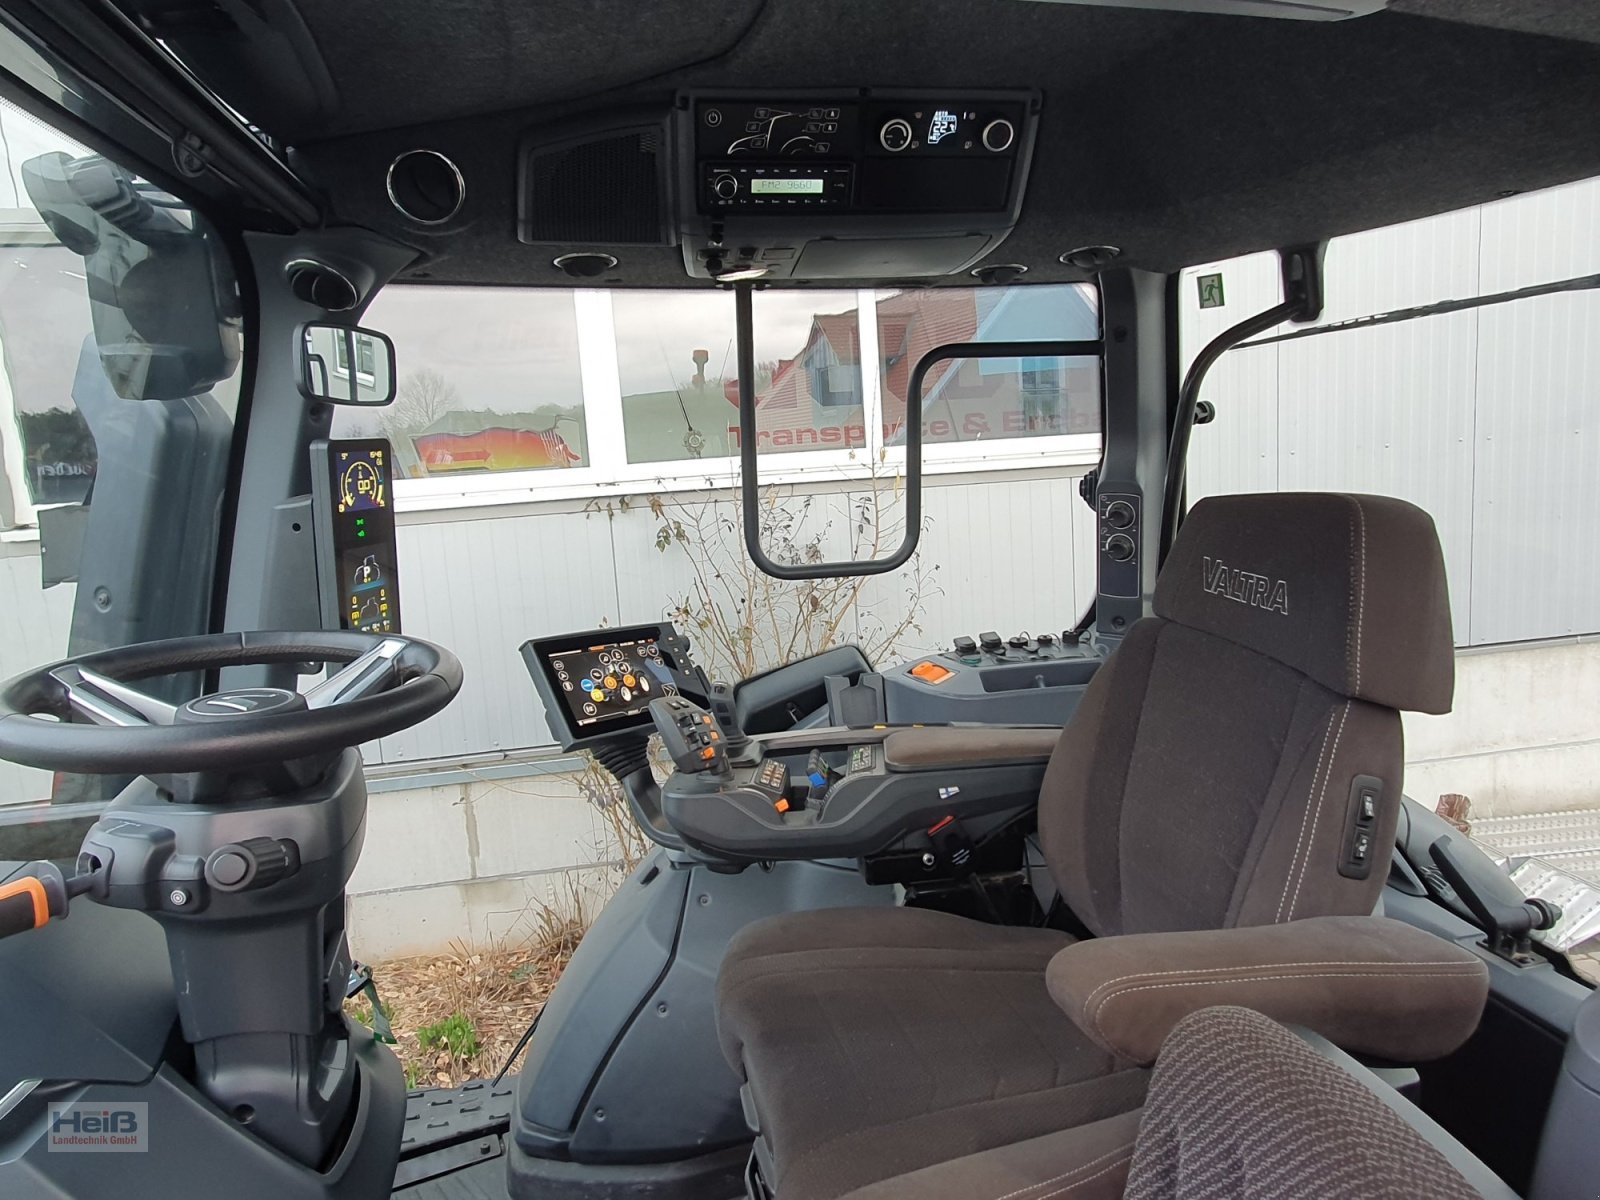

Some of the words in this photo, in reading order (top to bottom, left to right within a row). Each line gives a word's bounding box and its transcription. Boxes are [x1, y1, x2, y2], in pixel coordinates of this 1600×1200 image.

[761, 181, 780, 189] FM2
[962, 412, 991, 434] &
[1203, 556, 1288, 615] VALTRA
